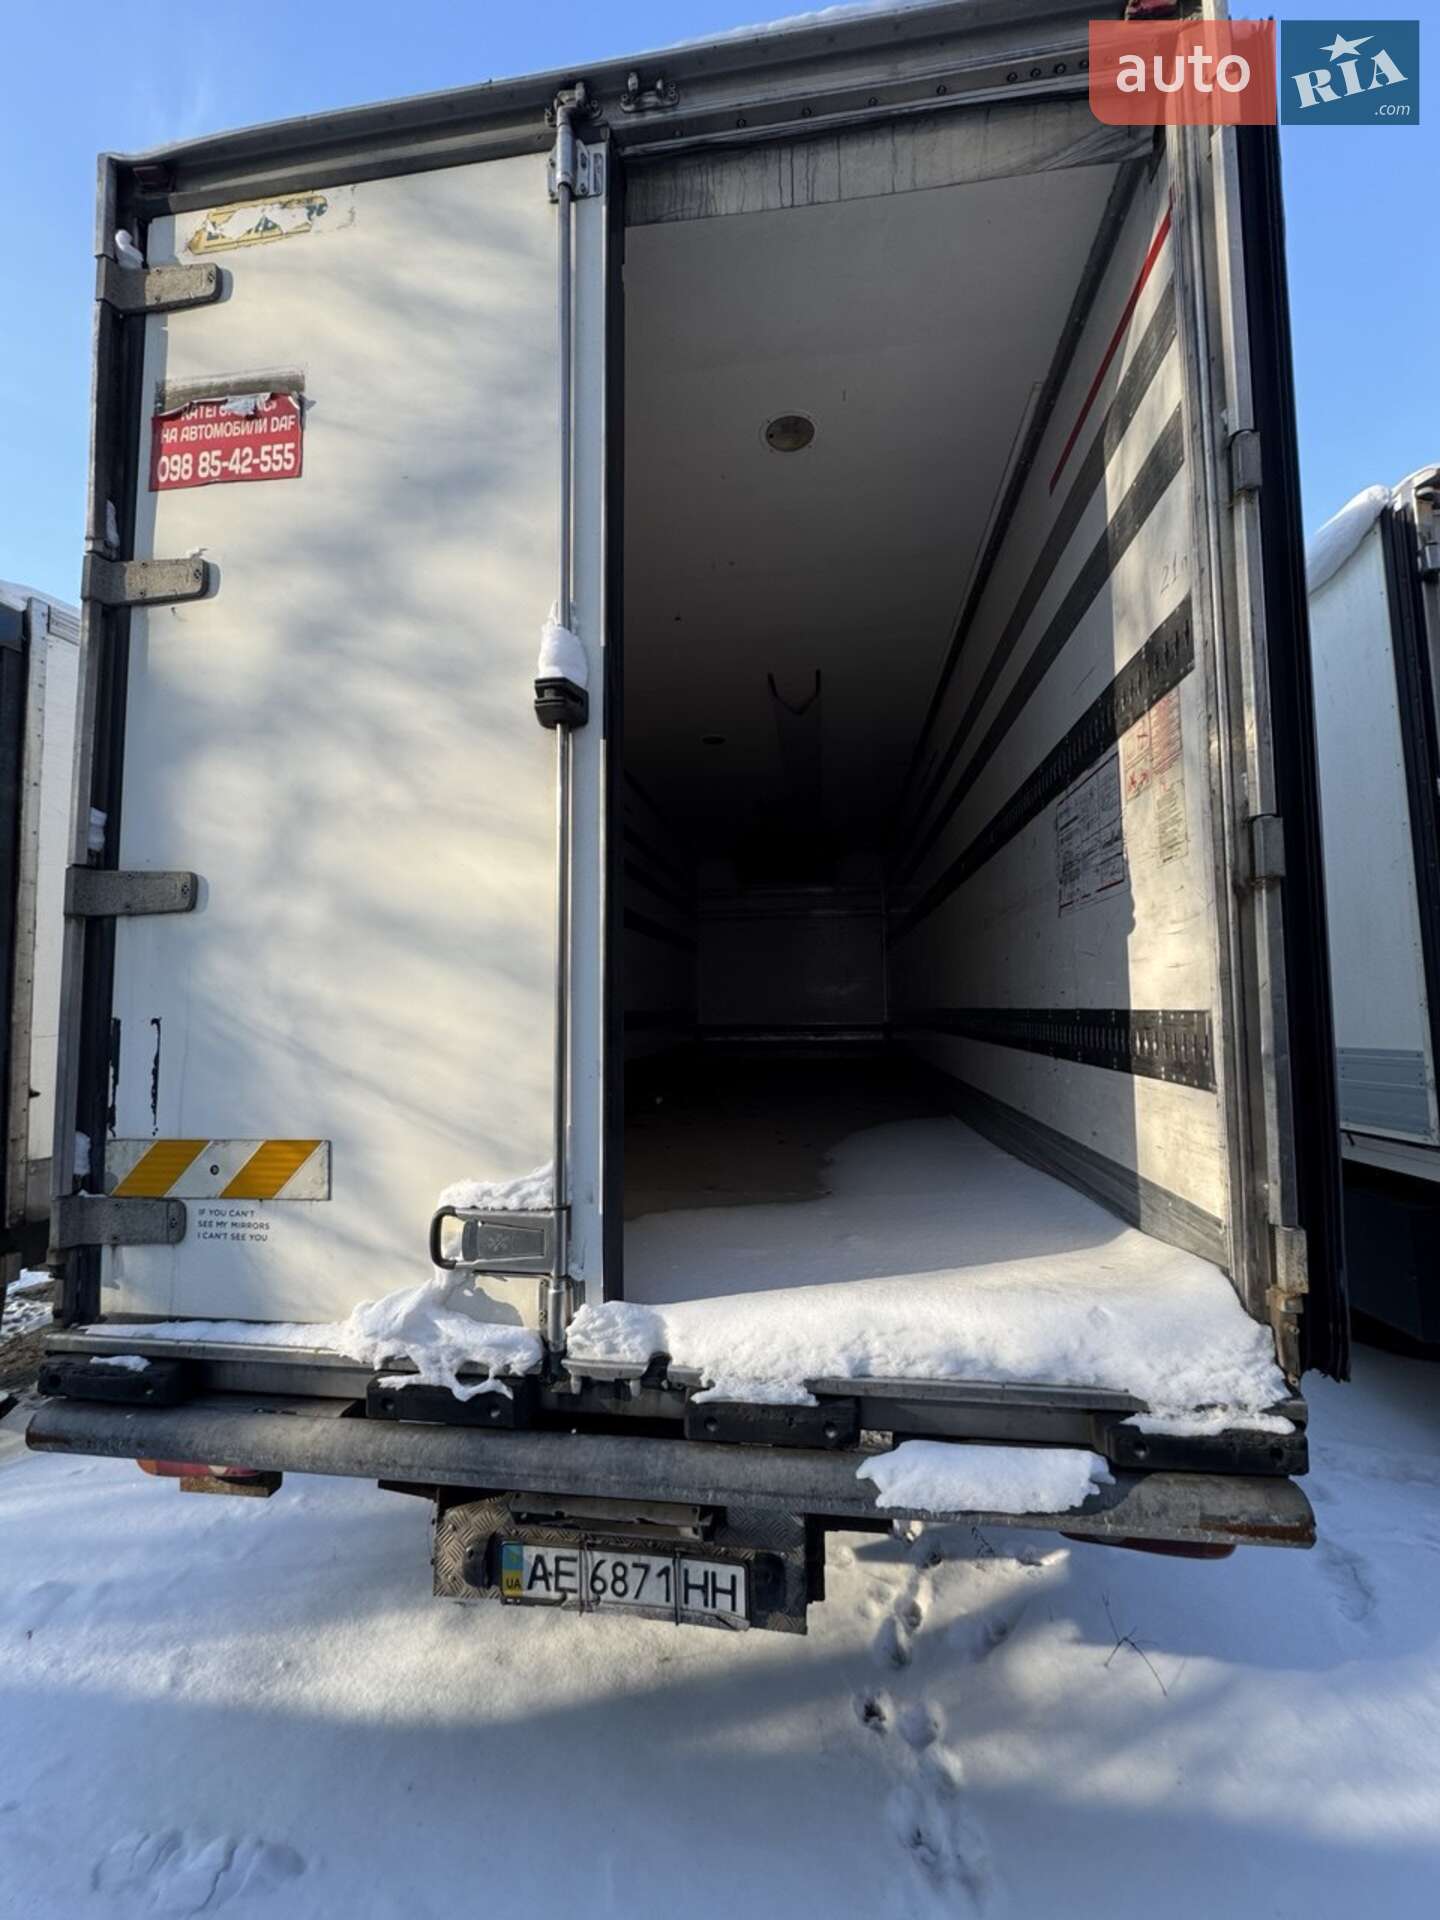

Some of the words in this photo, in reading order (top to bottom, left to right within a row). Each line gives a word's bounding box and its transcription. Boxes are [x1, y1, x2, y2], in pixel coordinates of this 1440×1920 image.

[160, 426, 179, 444] НА
[270, 414, 296, 432] DAF
[157, 453, 193, 482] 098
[198, 442, 296, 478] 85-42-555
[198, 1207, 206, 1216] IF
[209, 1208, 227, 1217] YOU
[228, 1209, 255, 1218] CAN'T
[198, 1220, 213, 1228] SEE
[215, 1220, 228, 1228] MY
[231, 1221, 270, 1231] MIRRORS
[202, 1231, 228, 1240] CAN'T
[230, 1232, 247, 1241] SEE
[249, 1233, 269, 1242] YOU
[505, 1577, 522, 1590] UA
[527, 1554, 578, 1594] AE
[589, 1559, 671, 1603] 6871
[683, 1567, 737, 1612] HH
